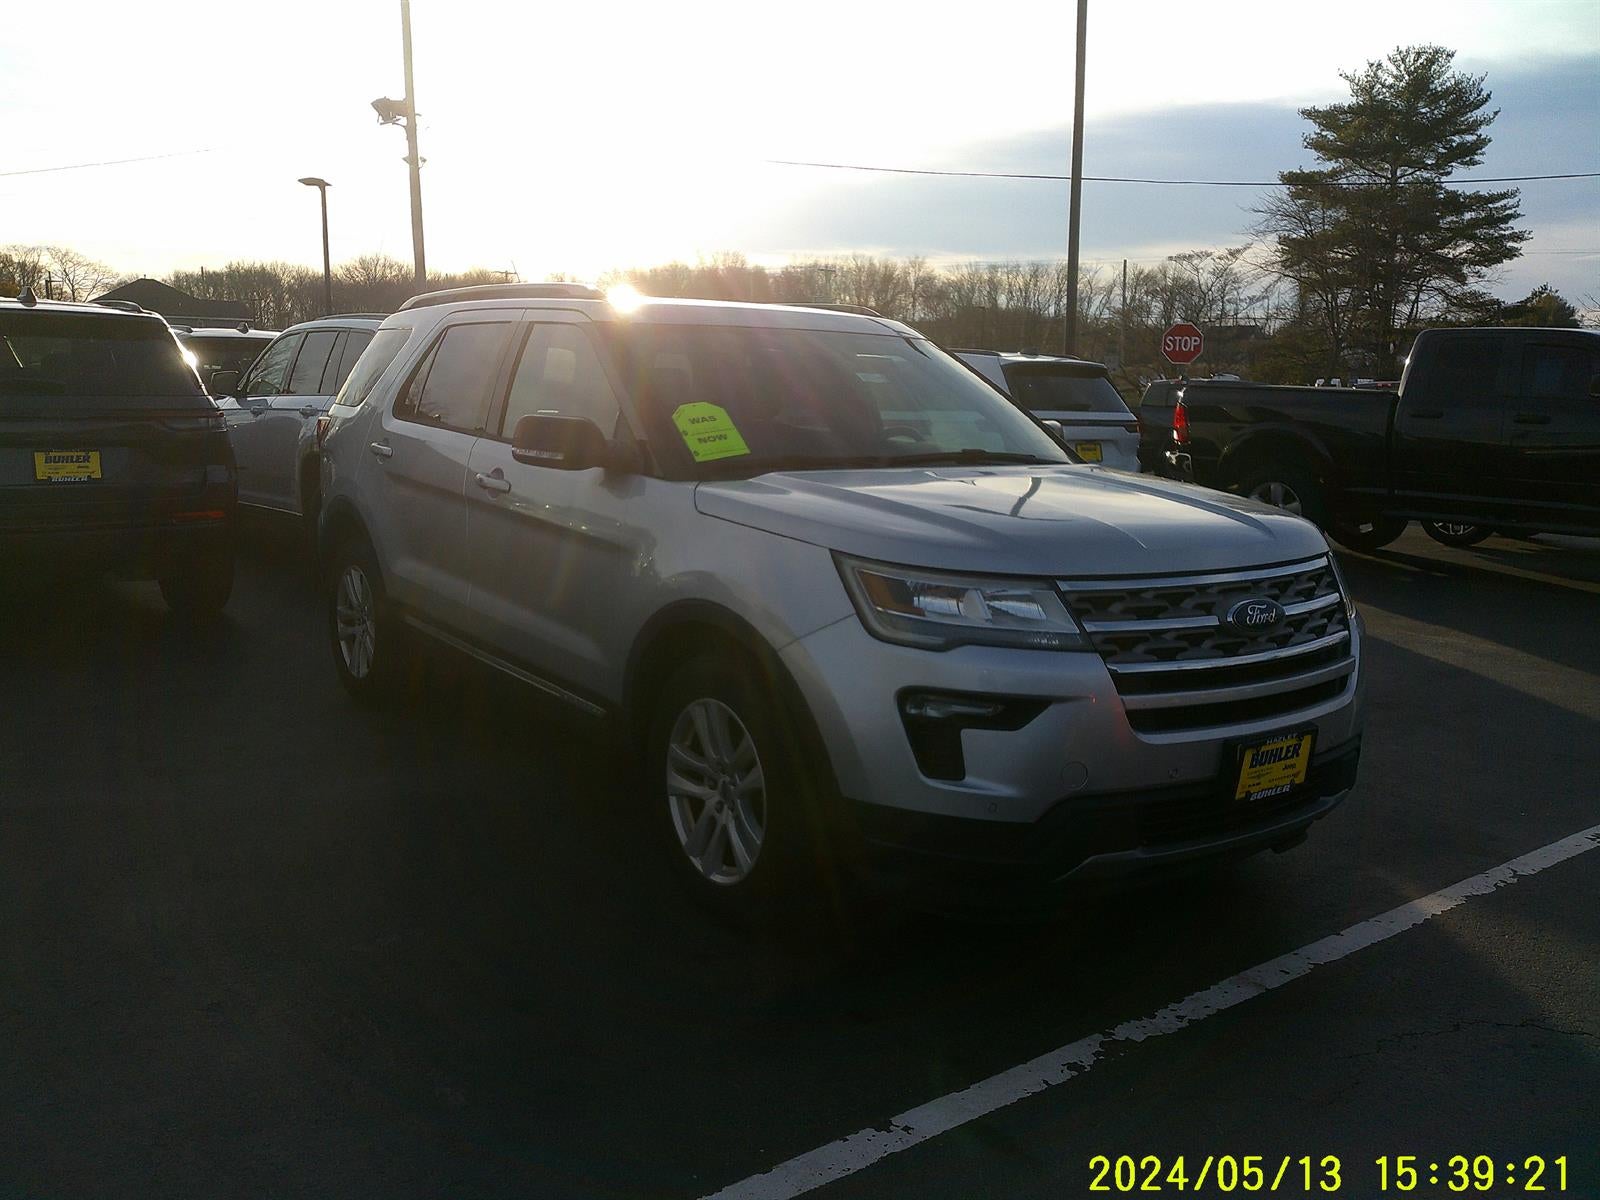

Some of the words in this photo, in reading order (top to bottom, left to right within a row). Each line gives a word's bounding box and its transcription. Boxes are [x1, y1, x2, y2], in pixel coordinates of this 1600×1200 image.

[1165, 336, 1201, 352] STOP
[688, 415, 718, 425] WAS
[697, 434, 728, 444] NOW
[45, 455, 91, 464] BUHLER
[1246, 604, 1277, 625] Ford
[1249, 743, 1302, 769] BUHLER
[1250, 785, 1292, 801] BUHLER
